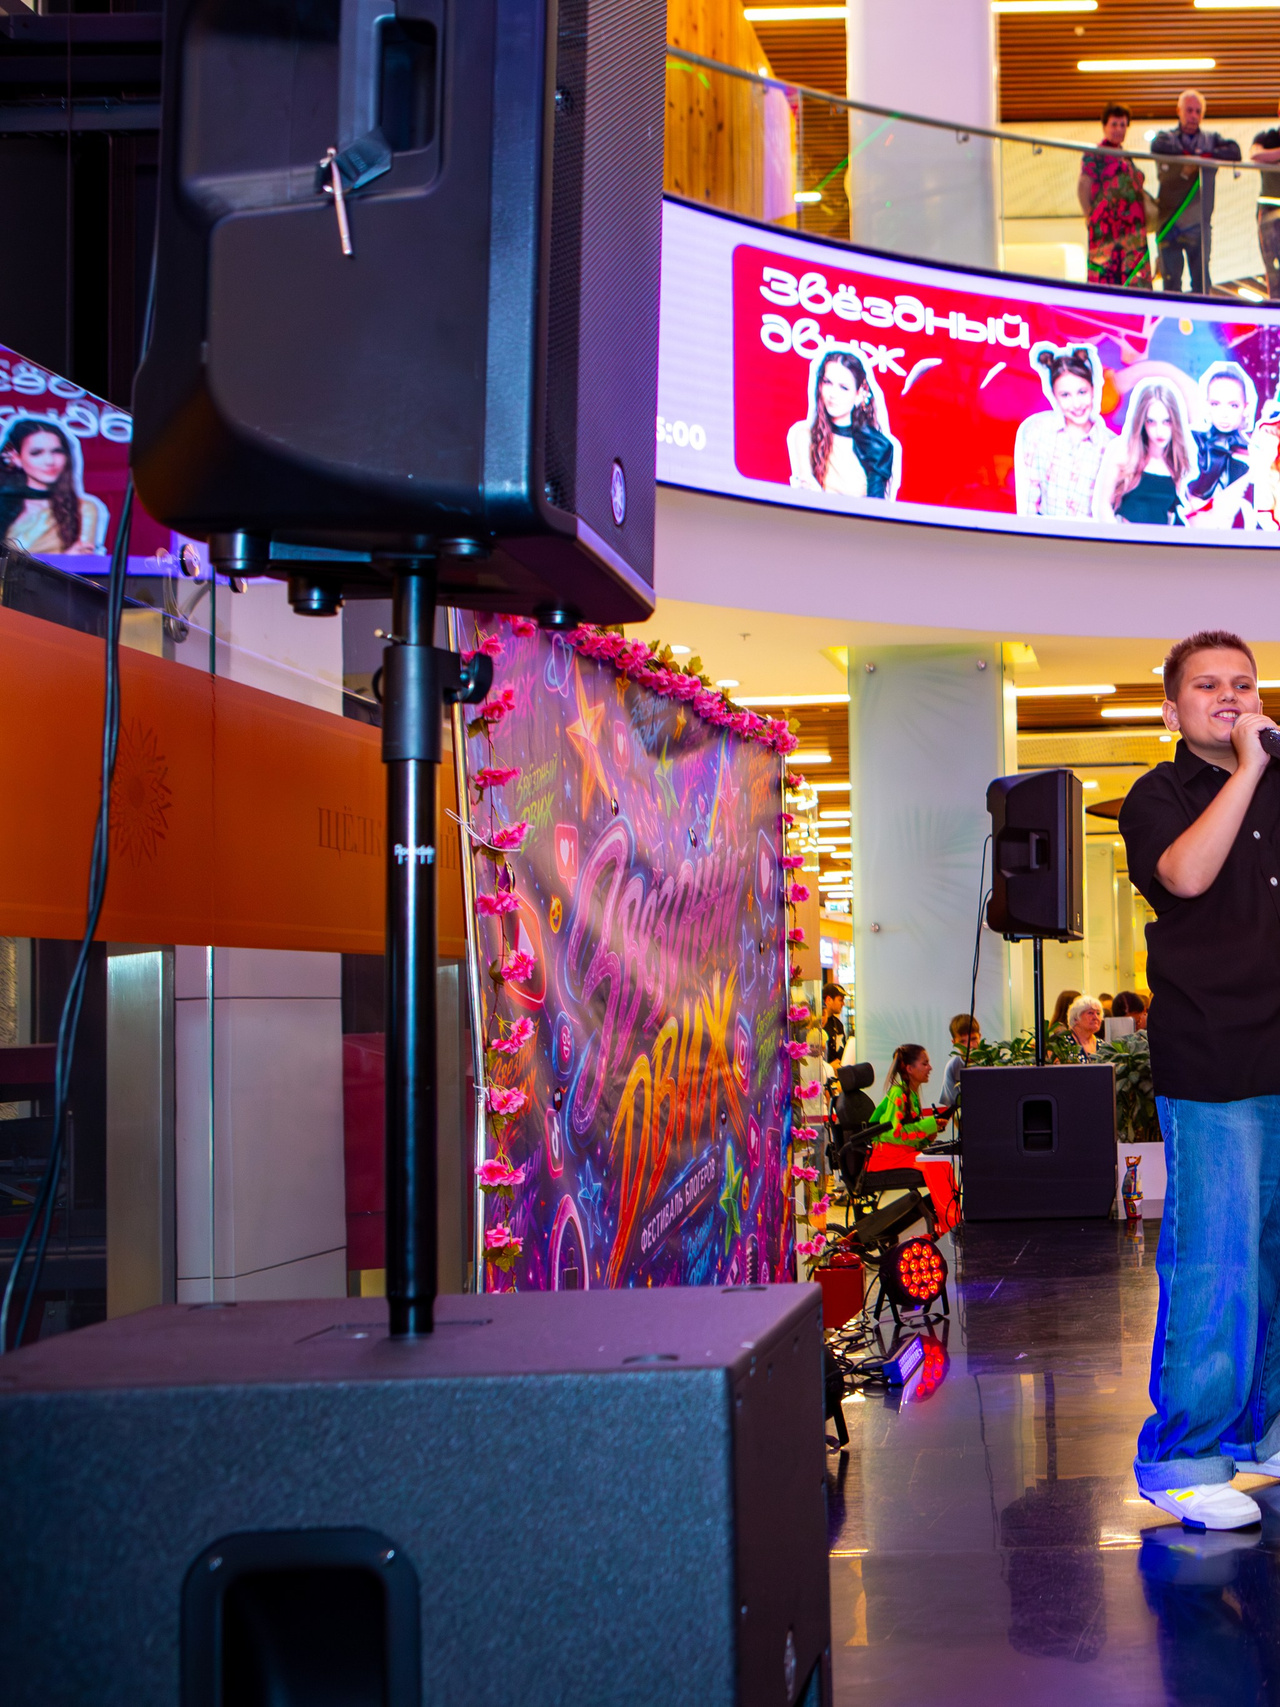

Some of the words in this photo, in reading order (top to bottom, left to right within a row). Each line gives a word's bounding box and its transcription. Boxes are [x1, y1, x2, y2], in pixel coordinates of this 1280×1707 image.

[760, 266, 1030, 349] Звёздный
[656, 415, 707, 451] 5:00
[641, 1191, 683, 1254] ФЕСТИВАЛЬ
[685, 1158, 716, 1207] БЛОГЕРОВ
